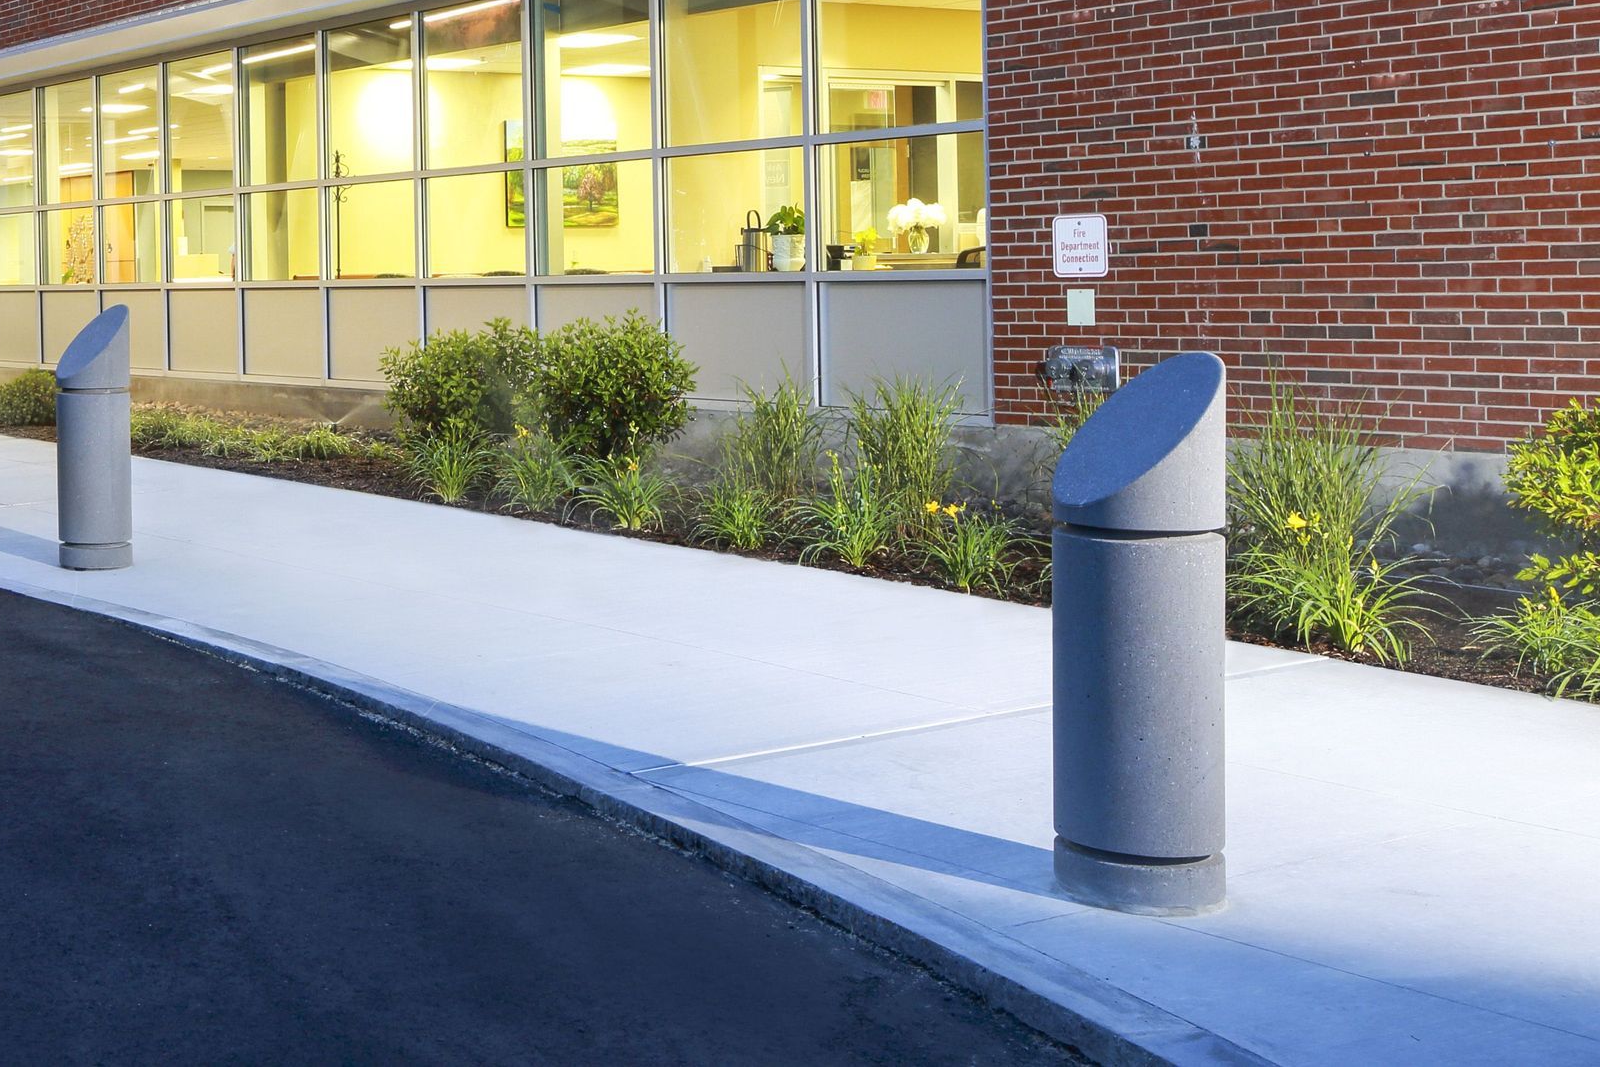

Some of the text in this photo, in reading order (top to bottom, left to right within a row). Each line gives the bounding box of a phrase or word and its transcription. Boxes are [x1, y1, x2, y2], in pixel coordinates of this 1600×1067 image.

[1073, 228, 1086, 238] Fire
[1061, 241, 1099, 252] Department
[1062, 254, 1099, 263] Connection
